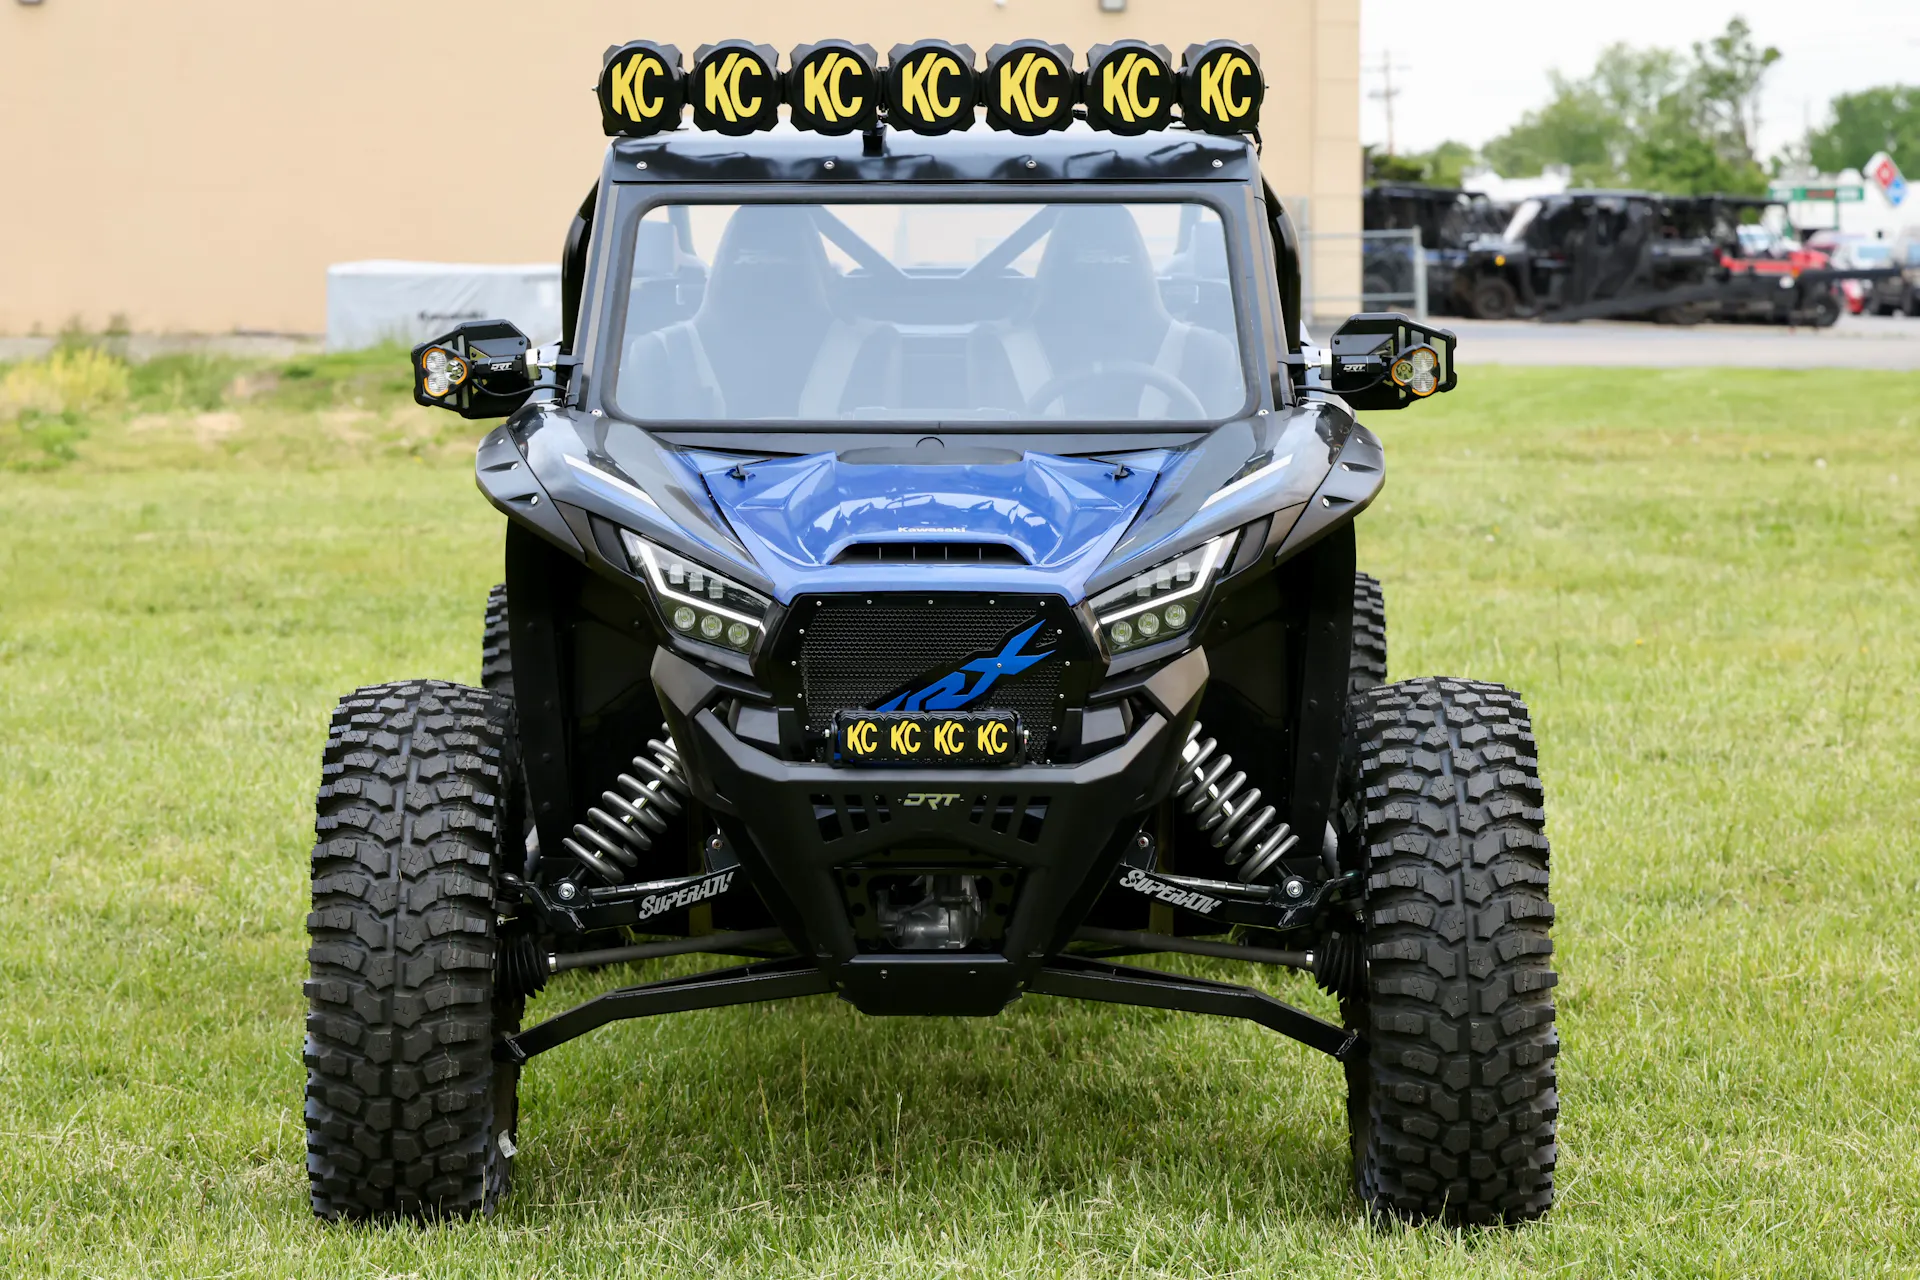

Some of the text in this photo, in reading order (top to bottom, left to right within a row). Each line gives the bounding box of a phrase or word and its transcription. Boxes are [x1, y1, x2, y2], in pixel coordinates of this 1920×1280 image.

[612, 53, 664, 122] KC
[705, 53, 762, 122] KC
[803, 53, 862, 122] KC
[902, 53, 961, 122] KC
[1000, 53, 1059, 122] KC
[1103, 53, 1160, 122] KC
[1200, 53, 1252, 122] KC
[847, 720, 1008, 755] KC KC KC KC
[903, 793, 961, 810] DRT
